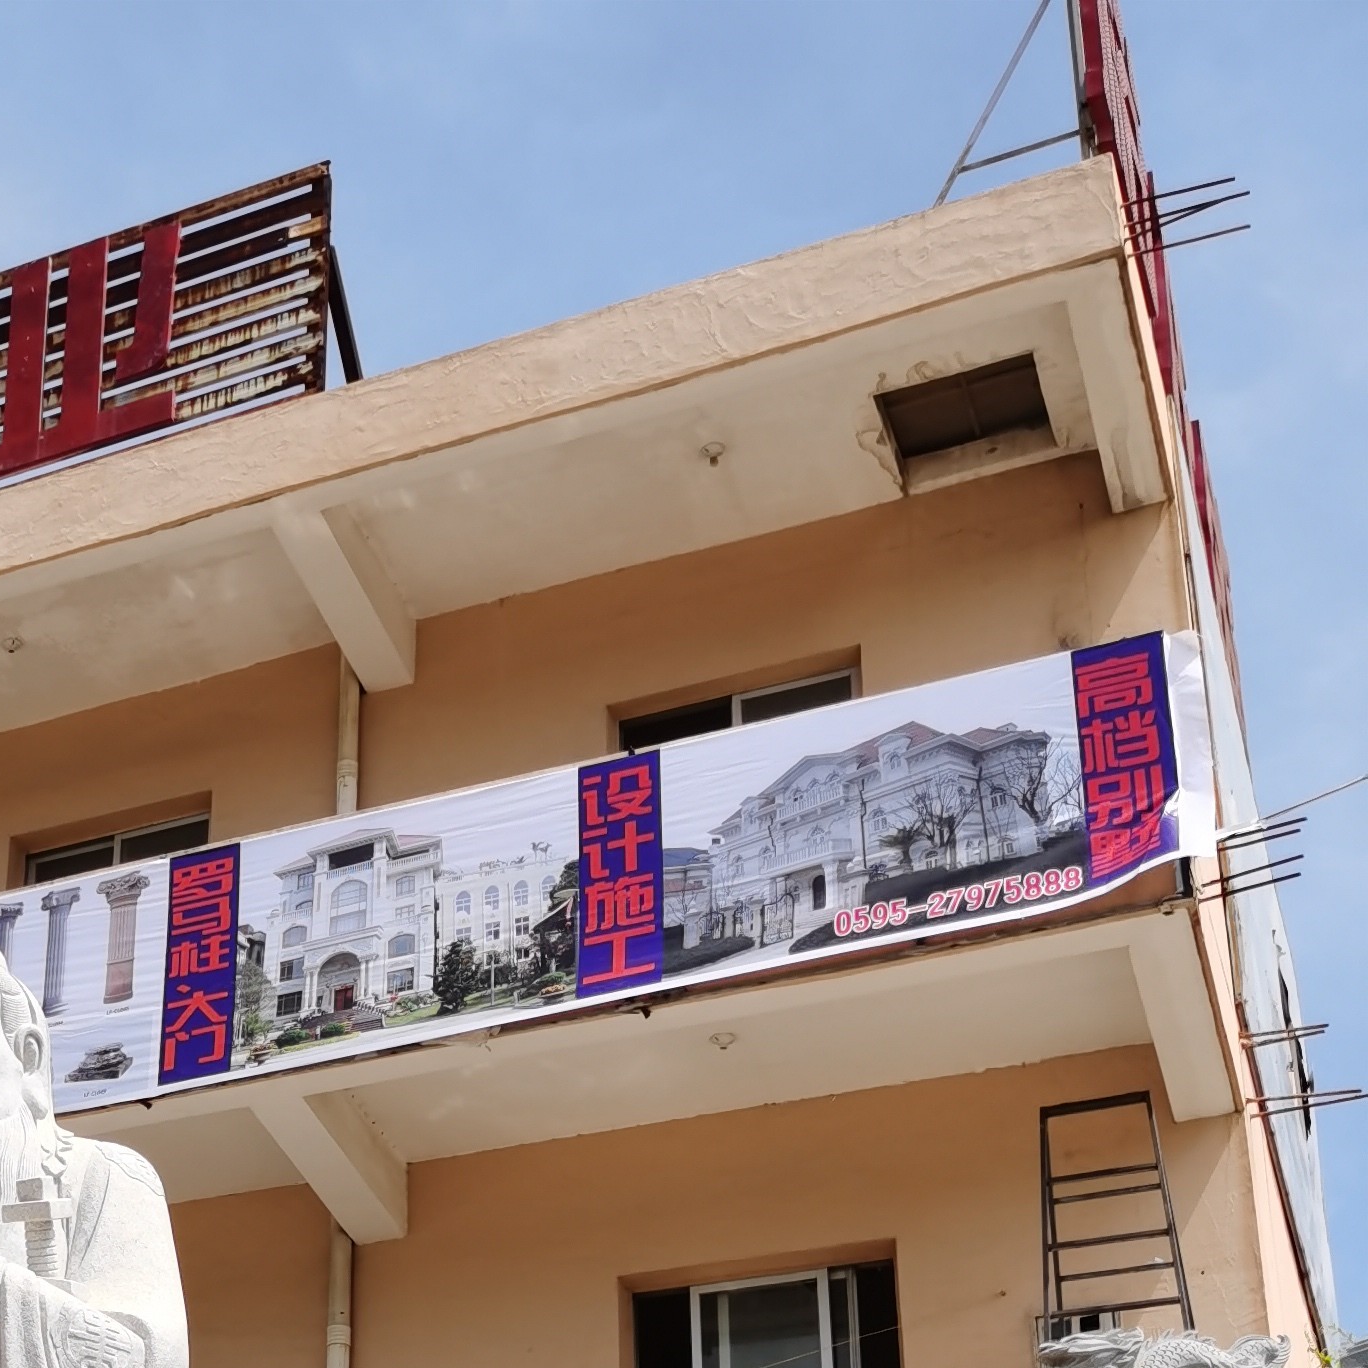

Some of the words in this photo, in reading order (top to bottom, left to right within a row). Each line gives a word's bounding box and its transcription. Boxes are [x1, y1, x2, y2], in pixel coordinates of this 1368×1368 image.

[582, 765, 655, 985] 设计施工
[1075, 653, 1164, 878] 高档别墅
[834, 866, 1082, 938] 0595-27975888
